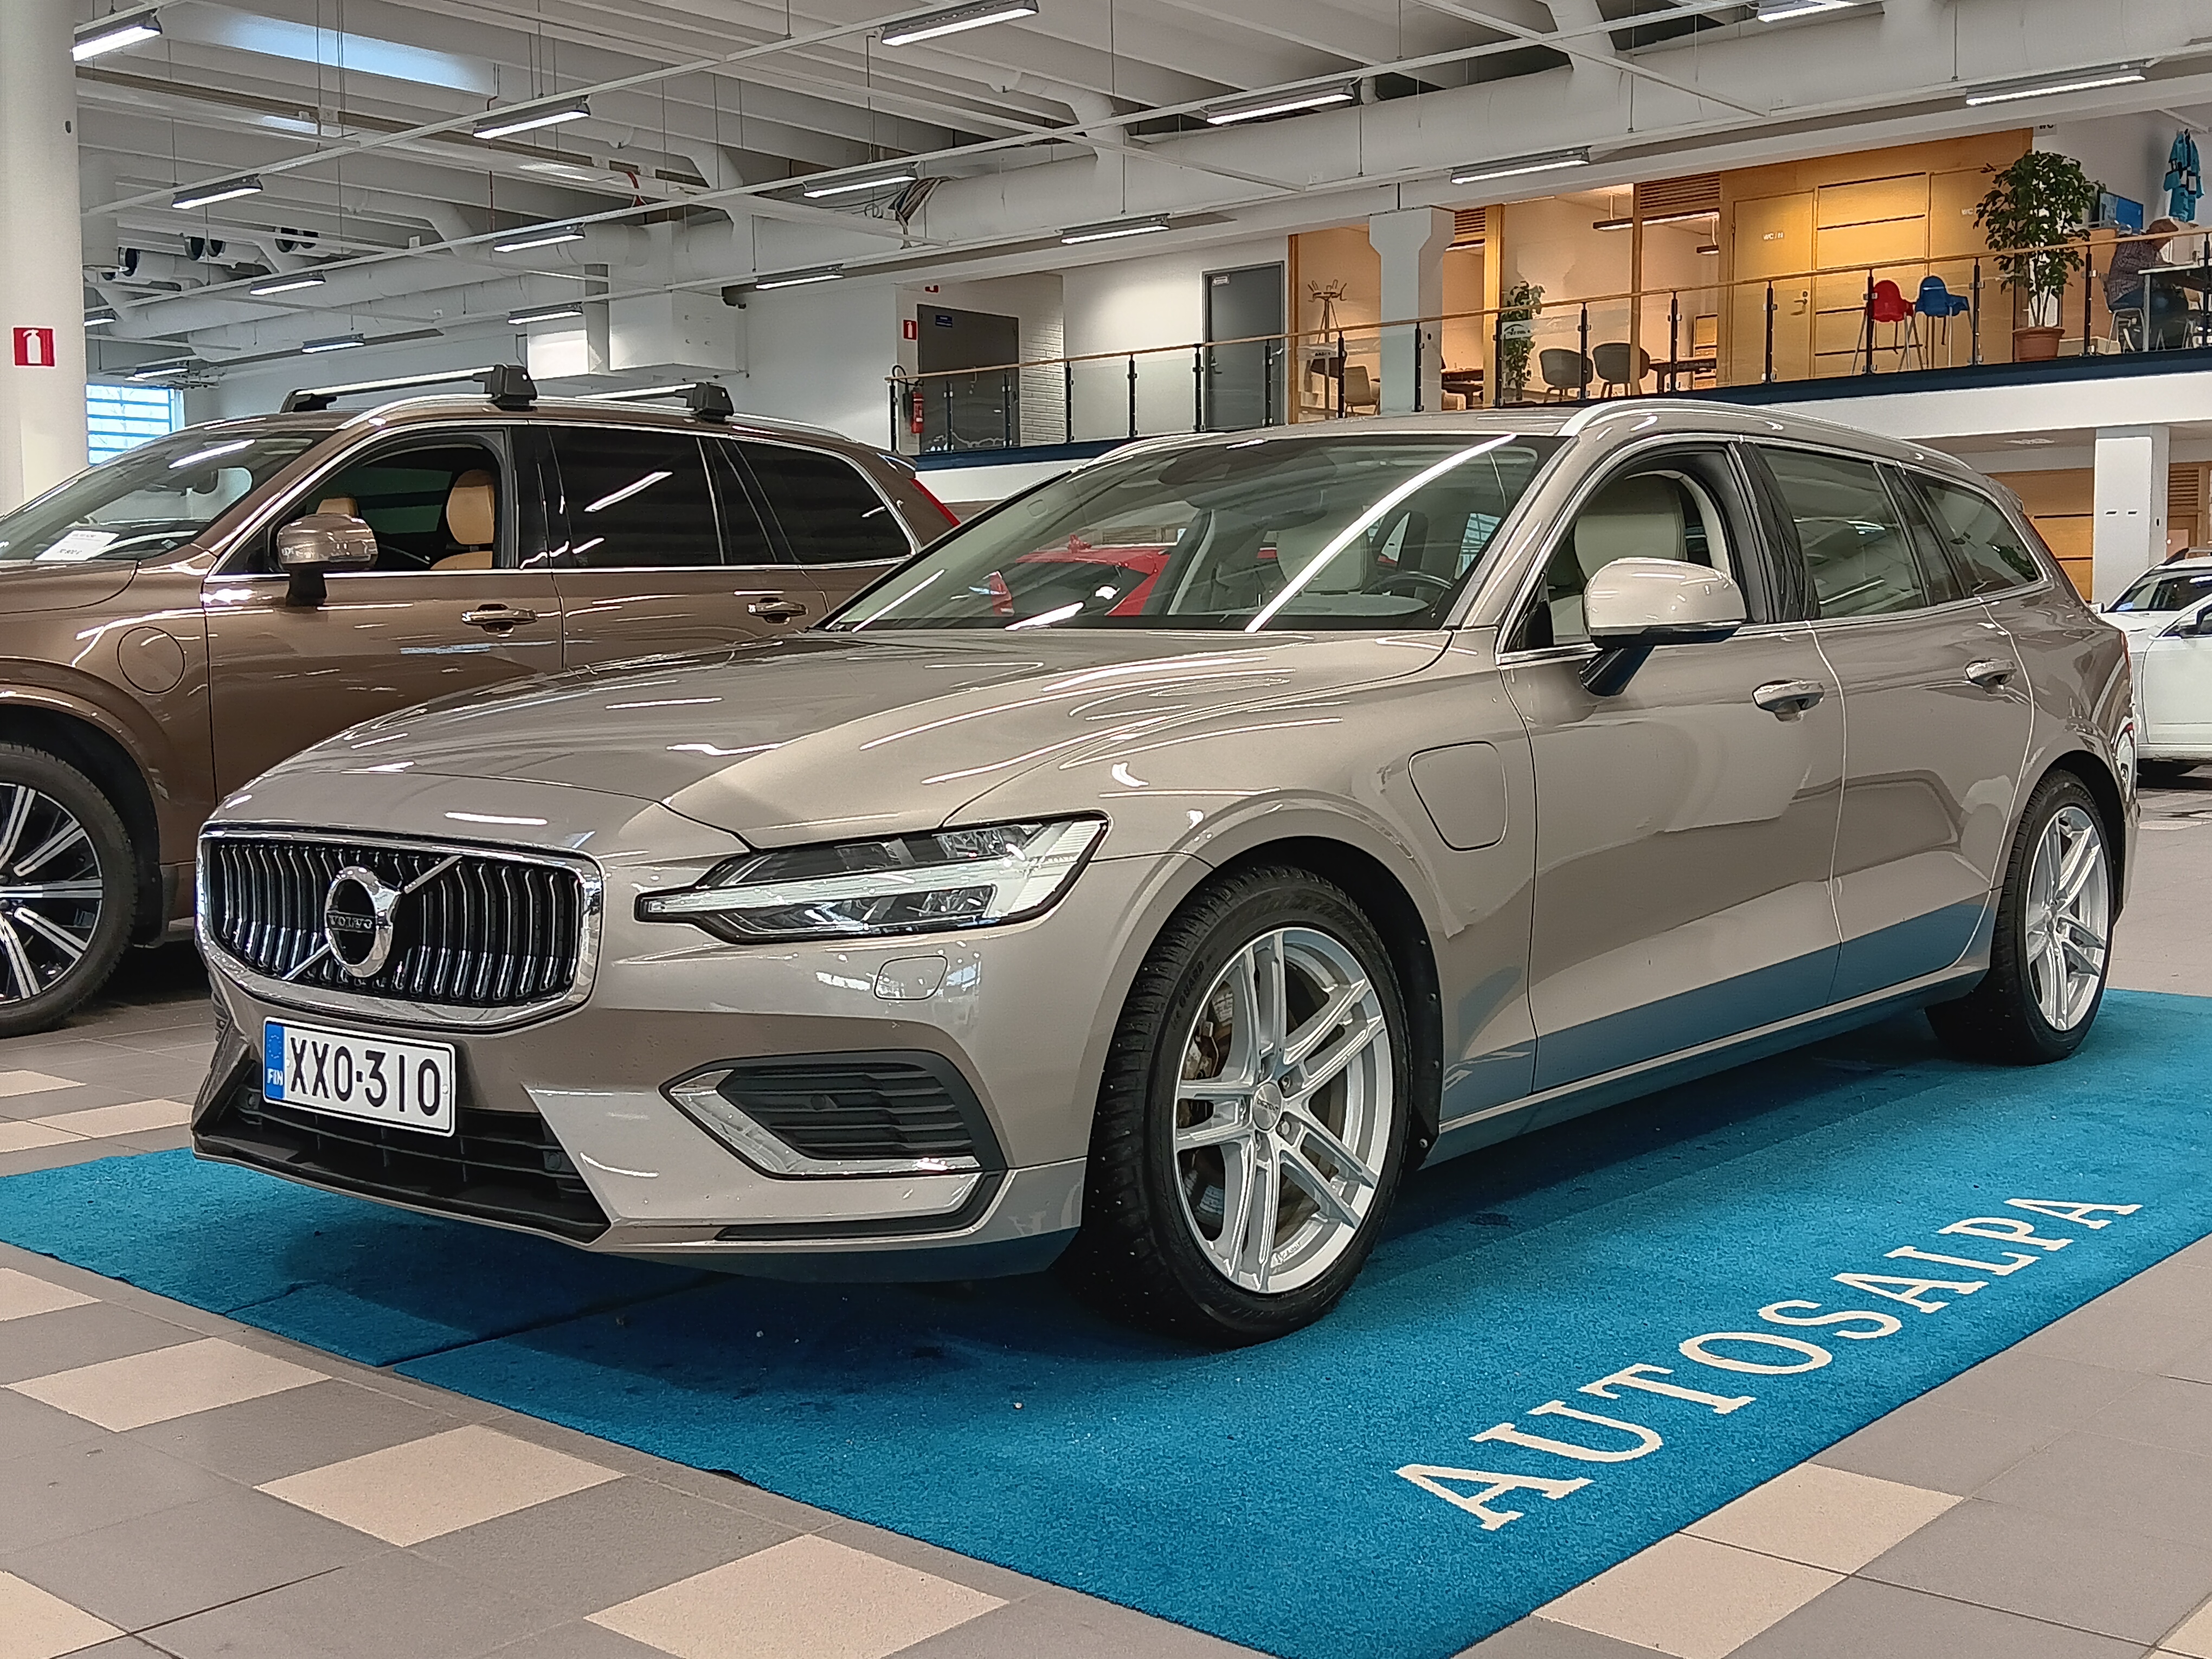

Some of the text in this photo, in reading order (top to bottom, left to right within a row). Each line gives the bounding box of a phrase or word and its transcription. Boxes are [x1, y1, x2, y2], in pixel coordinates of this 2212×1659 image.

[328, 914, 373, 929] VOLVO
[267, 1068, 284, 1086] FIN
[290, 1037, 441, 1117] XXO-310
[1394, 1197, 2144, 1531] AUTOSALPA
